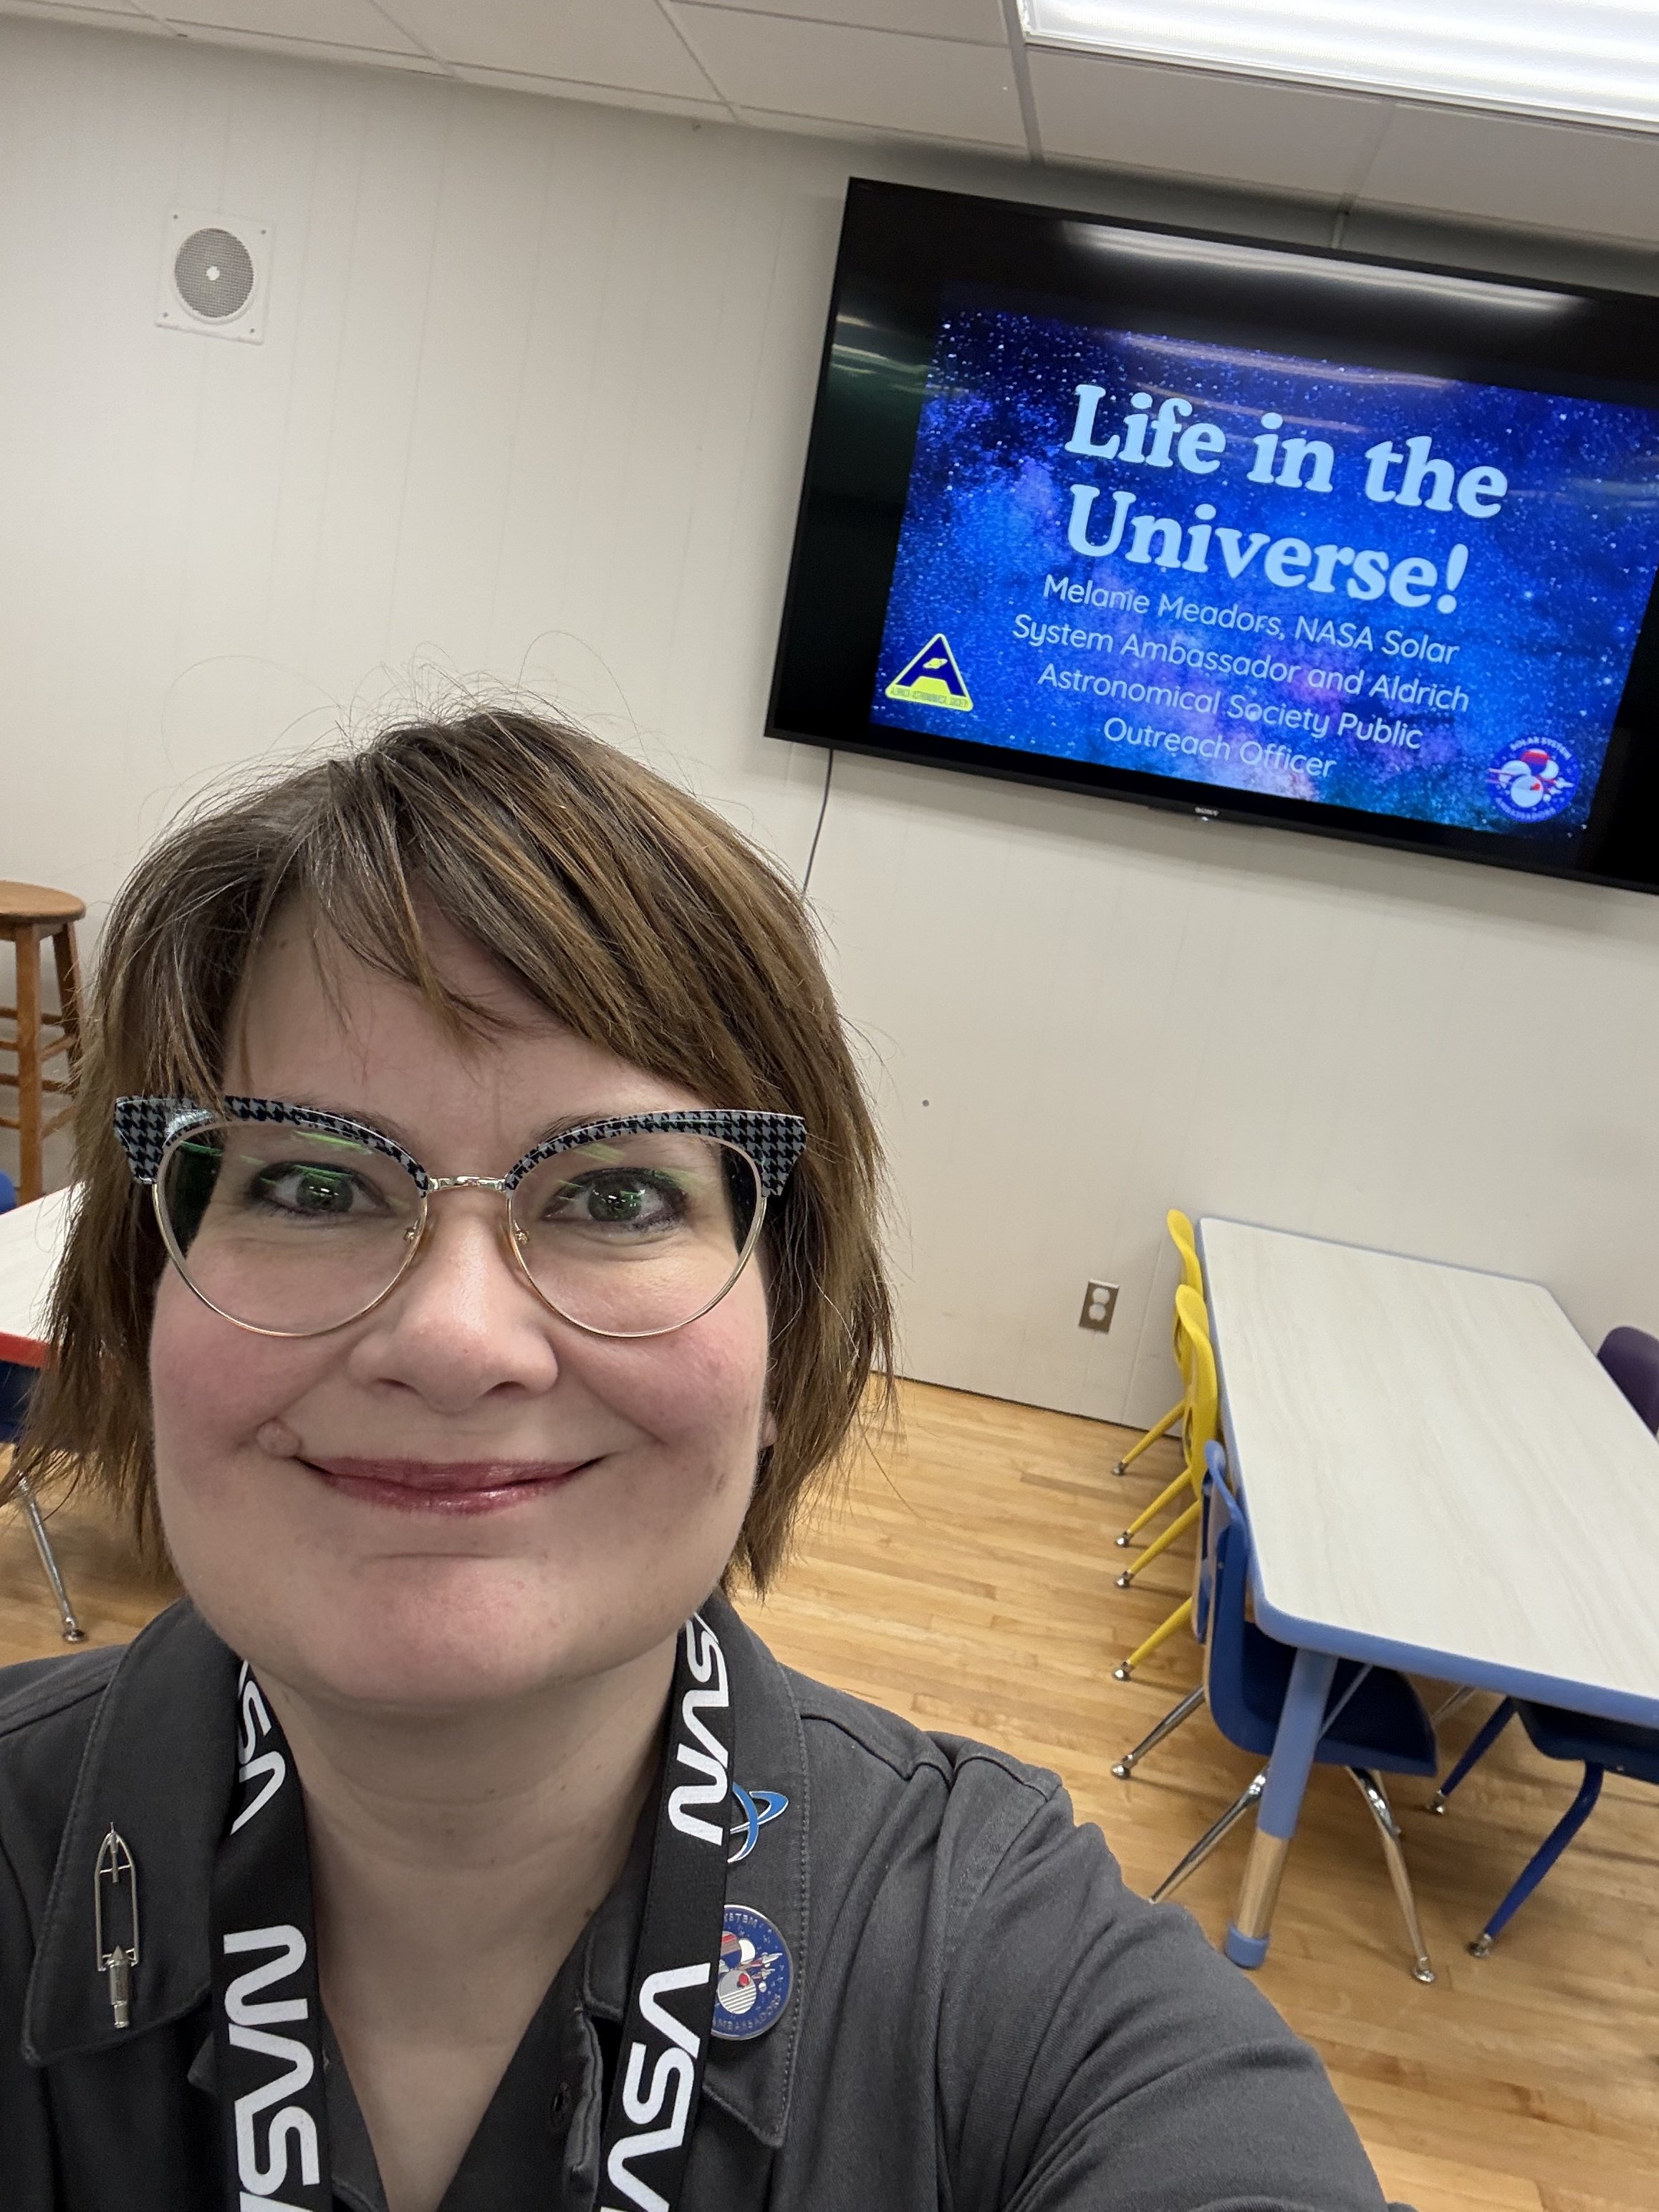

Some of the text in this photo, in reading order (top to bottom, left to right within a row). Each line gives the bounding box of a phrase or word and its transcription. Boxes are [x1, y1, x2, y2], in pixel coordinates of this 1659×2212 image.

[1064, 384, 1508, 518] Life in the
[1068, 484, 1468, 614] Universe!
[1012, 614, 1469, 712] System Ambassador and Aldrich
[1044, 574, 1461, 665] Melanie Meadors, NASA Solar
[1037, 663, 1423, 749] Astronomical Society Public
[1104, 717, 1337, 777] Outreach Officer
[600, 1962, 711, 2212] ASA
